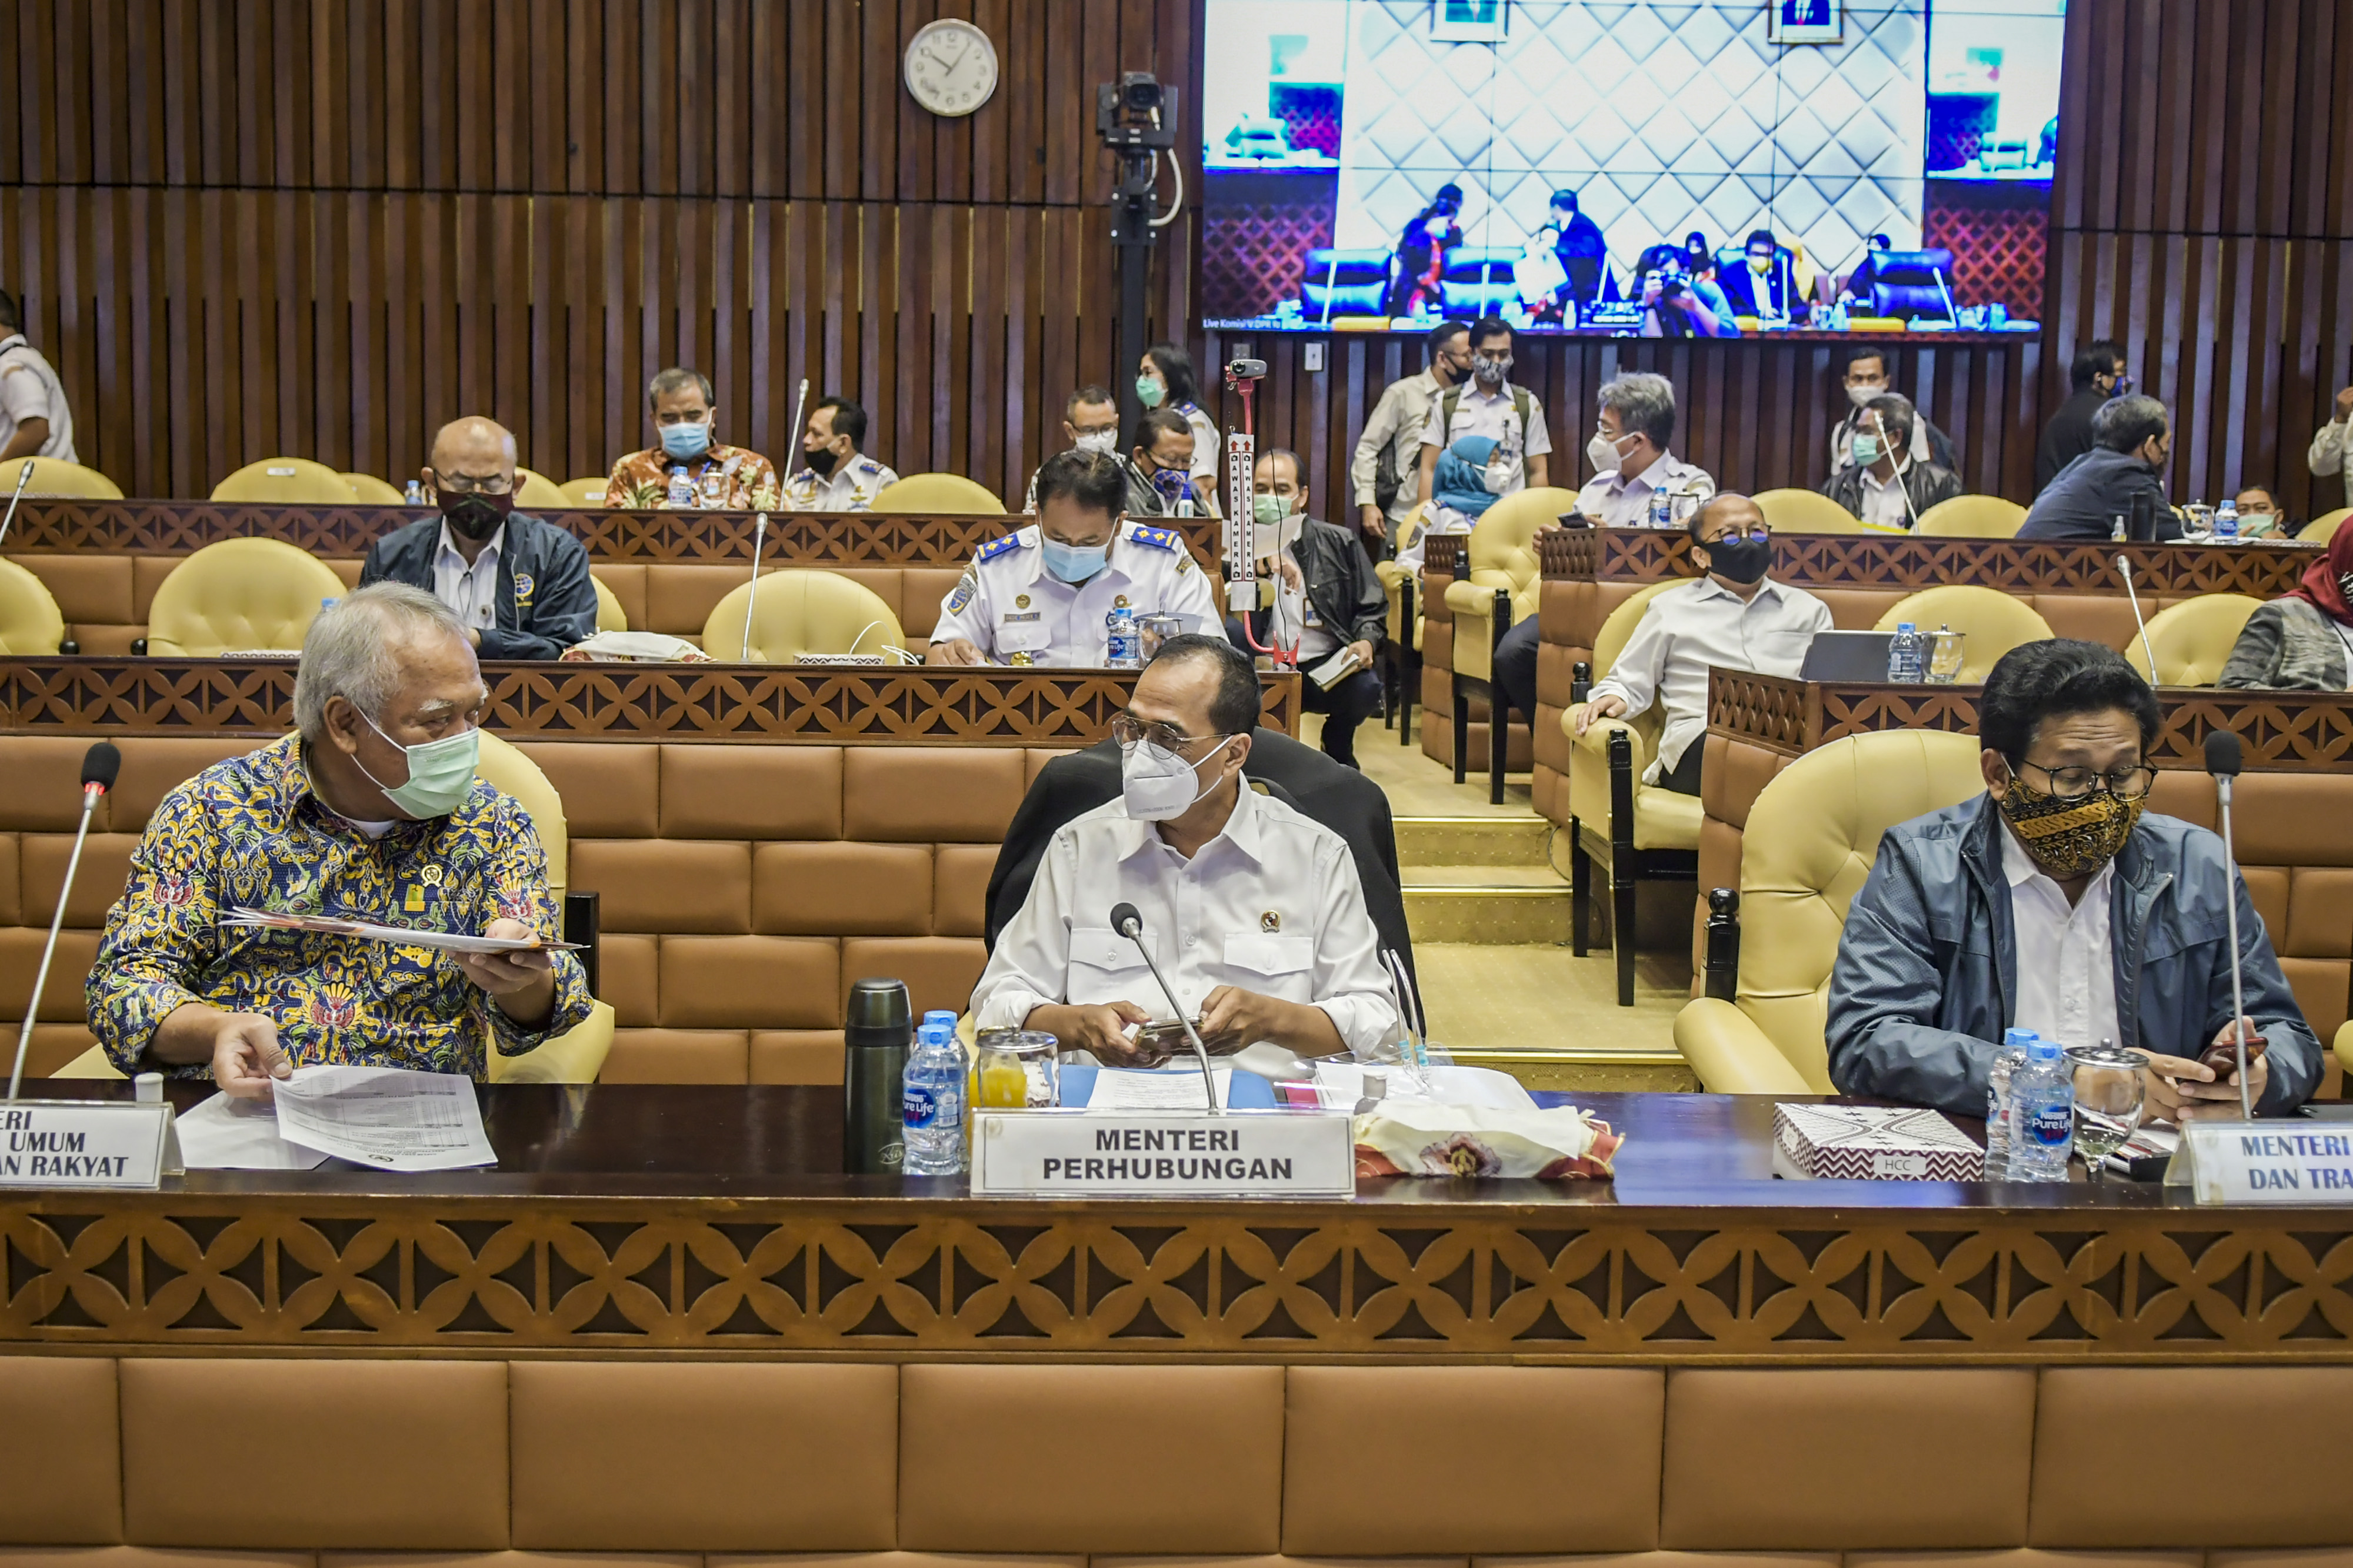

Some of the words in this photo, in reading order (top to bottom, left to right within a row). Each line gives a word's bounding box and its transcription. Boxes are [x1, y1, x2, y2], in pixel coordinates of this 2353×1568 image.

[916, 1102, 934, 1116] Life
[2032, 1118, 2058, 1129] Pure
[9, 1132, 85, 1152] UMUM
[1096, 1129, 1239, 1151] MENTERI
[2241, 1136, 2351, 1156] MENTERI
[31, 1156, 129, 1177] RAKYAT
[1044, 1158, 1292, 1179] PERHUBUNGAN
[1885, 1159, 1911, 1170] HCC
[2249, 1169, 2299, 1189] DAN
